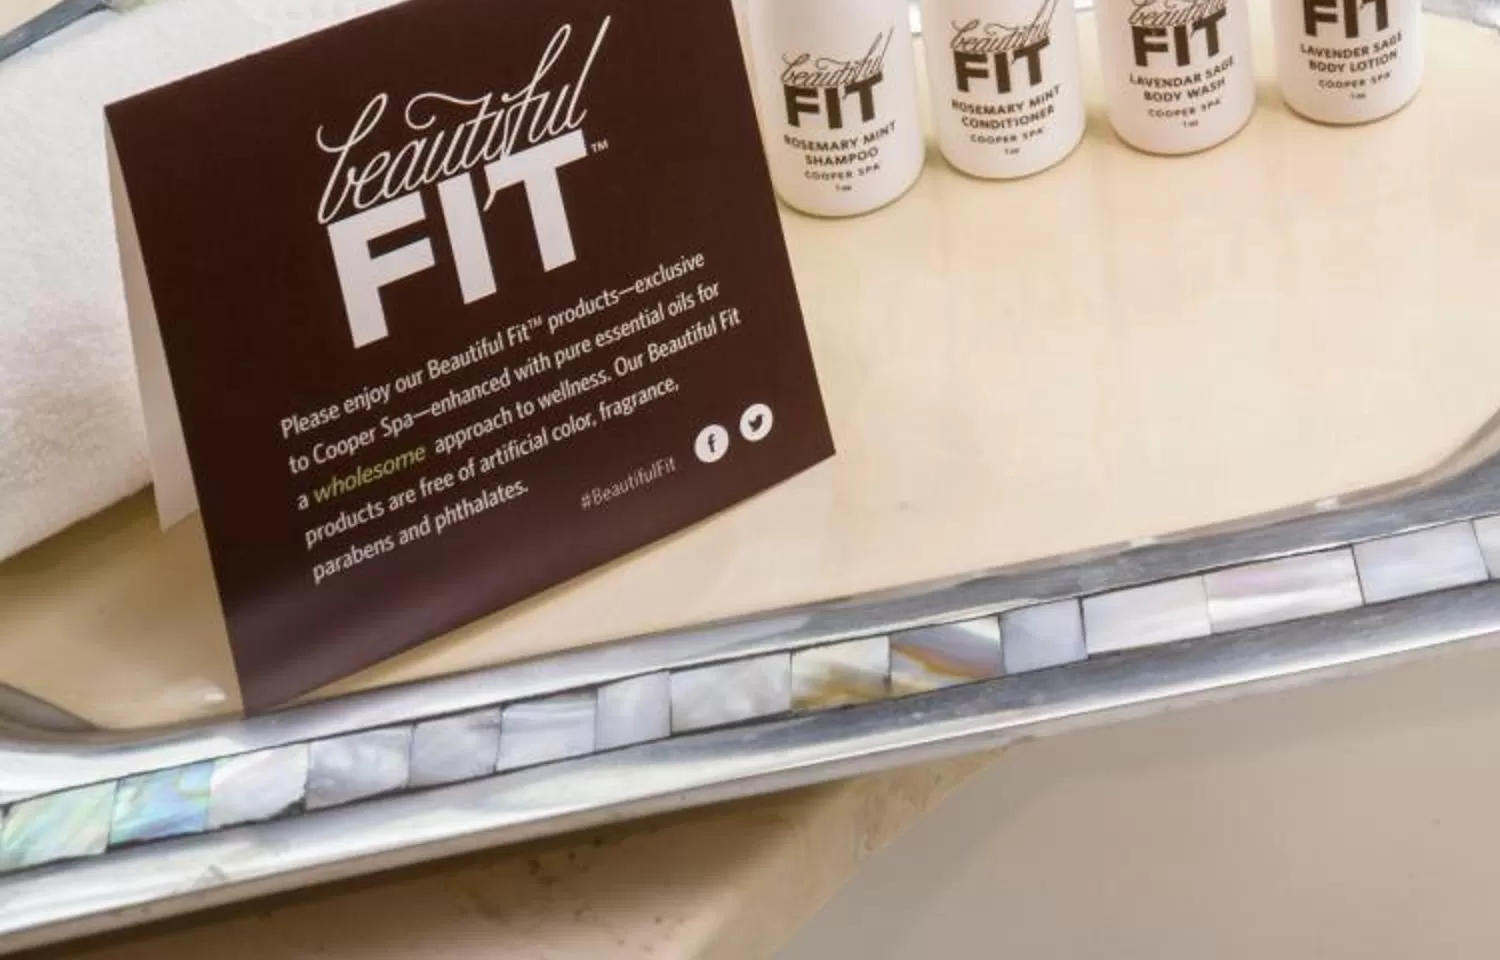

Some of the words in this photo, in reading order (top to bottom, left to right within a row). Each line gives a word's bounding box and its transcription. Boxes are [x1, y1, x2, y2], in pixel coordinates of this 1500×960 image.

[1131, 8, 1227, 68] FIT
[1300, 43, 1369, 59] LAVENDER
[1373, 31, 1402, 52] SAGE
[781, 25, 895, 86] beautiful
[953, 36, 1050, 94] FIT
[1205, 55, 1234, 79] SAGE
[1308, 59, 1345, 73] BODY
[1349, 49, 1398, 72] LOTION
[1143, 90, 1181, 102] BODY
[1187, 76, 1225, 99] WASH
[1318, 79, 1366, 89] COOPER
[1371, 72, 1391, 84] SPA
[783, 72, 884, 130] FIT
[952, 98, 1024, 115] ROSEMARY
[1029, 85, 1060, 108] MINT
[1148, 107, 1196, 118] COOPER
[316, 15, 612, 225] beautiful
[961, 104, 1055, 129] CONDITIONER
[783, 133, 858, 151] ROSEMARY
[863, 121, 896, 144] MINT
[970, 133, 1017, 144] COOPER
[805, 146, 879, 166] SHAMPOO
[804, 170, 853, 180] COOPER
[858, 163, 880, 176] SPA
[281, 404, 340, 439] Please
[344, 383, 391, 415] enjoy
[395, 370, 424, 393] our
[427, 332, 504, 380] Beautiful
[288, 455, 309, 474] to
[313, 427, 377, 464] Cooper
[514, 354, 551, 382] with
[555, 339, 592, 368] pure
[595, 303, 664, 347] essential
[667, 292, 695, 317] oils
[697, 281, 720, 304] for
[298, 494, 309, 510] a
[313, 446, 426, 504] wholesome
[435, 406, 513, 455] approach
[517, 400, 535, 420] to
[537, 367, 612, 409] wellness.
[613, 352, 644, 377] Our
[647, 317, 717, 363] Beautiful
[718, 307, 742, 331] Fit
[305, 500, 385, 551] products
[389, 487, 417, 512] are
[419, 472, 454, 497] free
[458, 457, 477, 482] of
[480, 424, 549, 473] artificial
[551, 411, 597, 442] color,
[599, 377, 680, 421] fragrance,
[580, 455, 676, 511] #BeautifulFit
[312, 533, 395, 585] parabens
[399, 515, 431, 546] and
[434, 480, 529, 534] phthalates.
